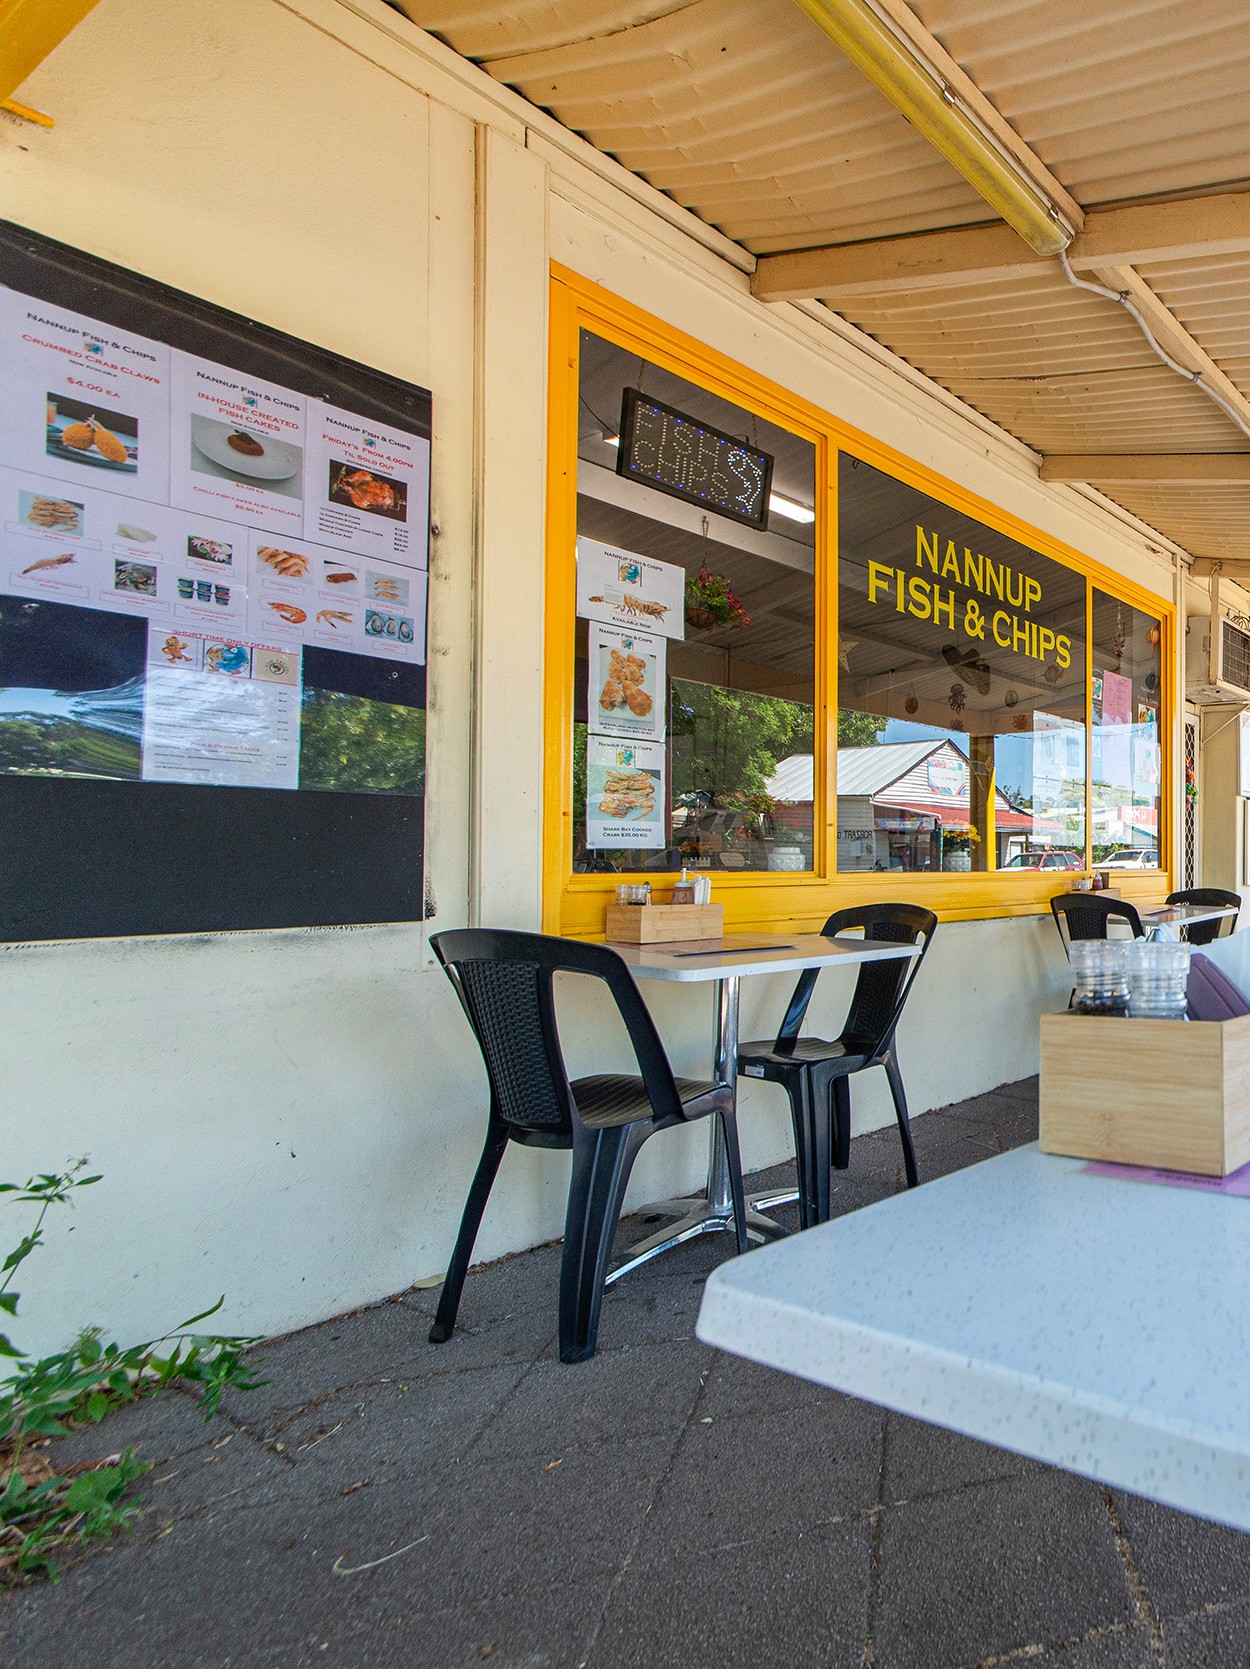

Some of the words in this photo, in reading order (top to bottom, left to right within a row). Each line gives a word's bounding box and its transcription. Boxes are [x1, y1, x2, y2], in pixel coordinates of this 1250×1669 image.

[27, 312, 79, 334] NANNUP
[82, 331, 109, 346] FISH
[122, 345, 156, 362] CHIPS
[22, 334, 82, 358] CRUMBED
[85, 355, 118, 370] CRAB
[120, 366, 160, 384] CLAWS
[196, 371, 239, 390] NANNUP
[240, 386, 262, 399] FISH
[273, 398, 300, 412] CHIPS
[197, 391, 250, 413] IN-HOUSE
[251, 409, 299, 430] CREATED
[218, 407, 243, 420] FISH
[245, 416, 281, 432] CAKES
[326, 416, 361, 432] NANNUP
[362, 429, 380, 440] FISH
[388, 438, 411, 451] CHIPS
[635, 406, 720, 470] FISH
[357, 454, 378, 466] SOLD
[378, 461, 395, 471] OUT
[362, 447, 384, 459] FROM
[633, 440, 729, 499] CHIPS
[604, 551, 629, 561] NANNUP
[647, 563, 663, 572] CHIPS
[915, 524, 1043, 613] NANNUP
[867, 559, 955, 630] FISH
[964, 598, 985, 640] &
[992, 610, 1072, 669] CHIPS
[204, 634, 225, 643] TIME
